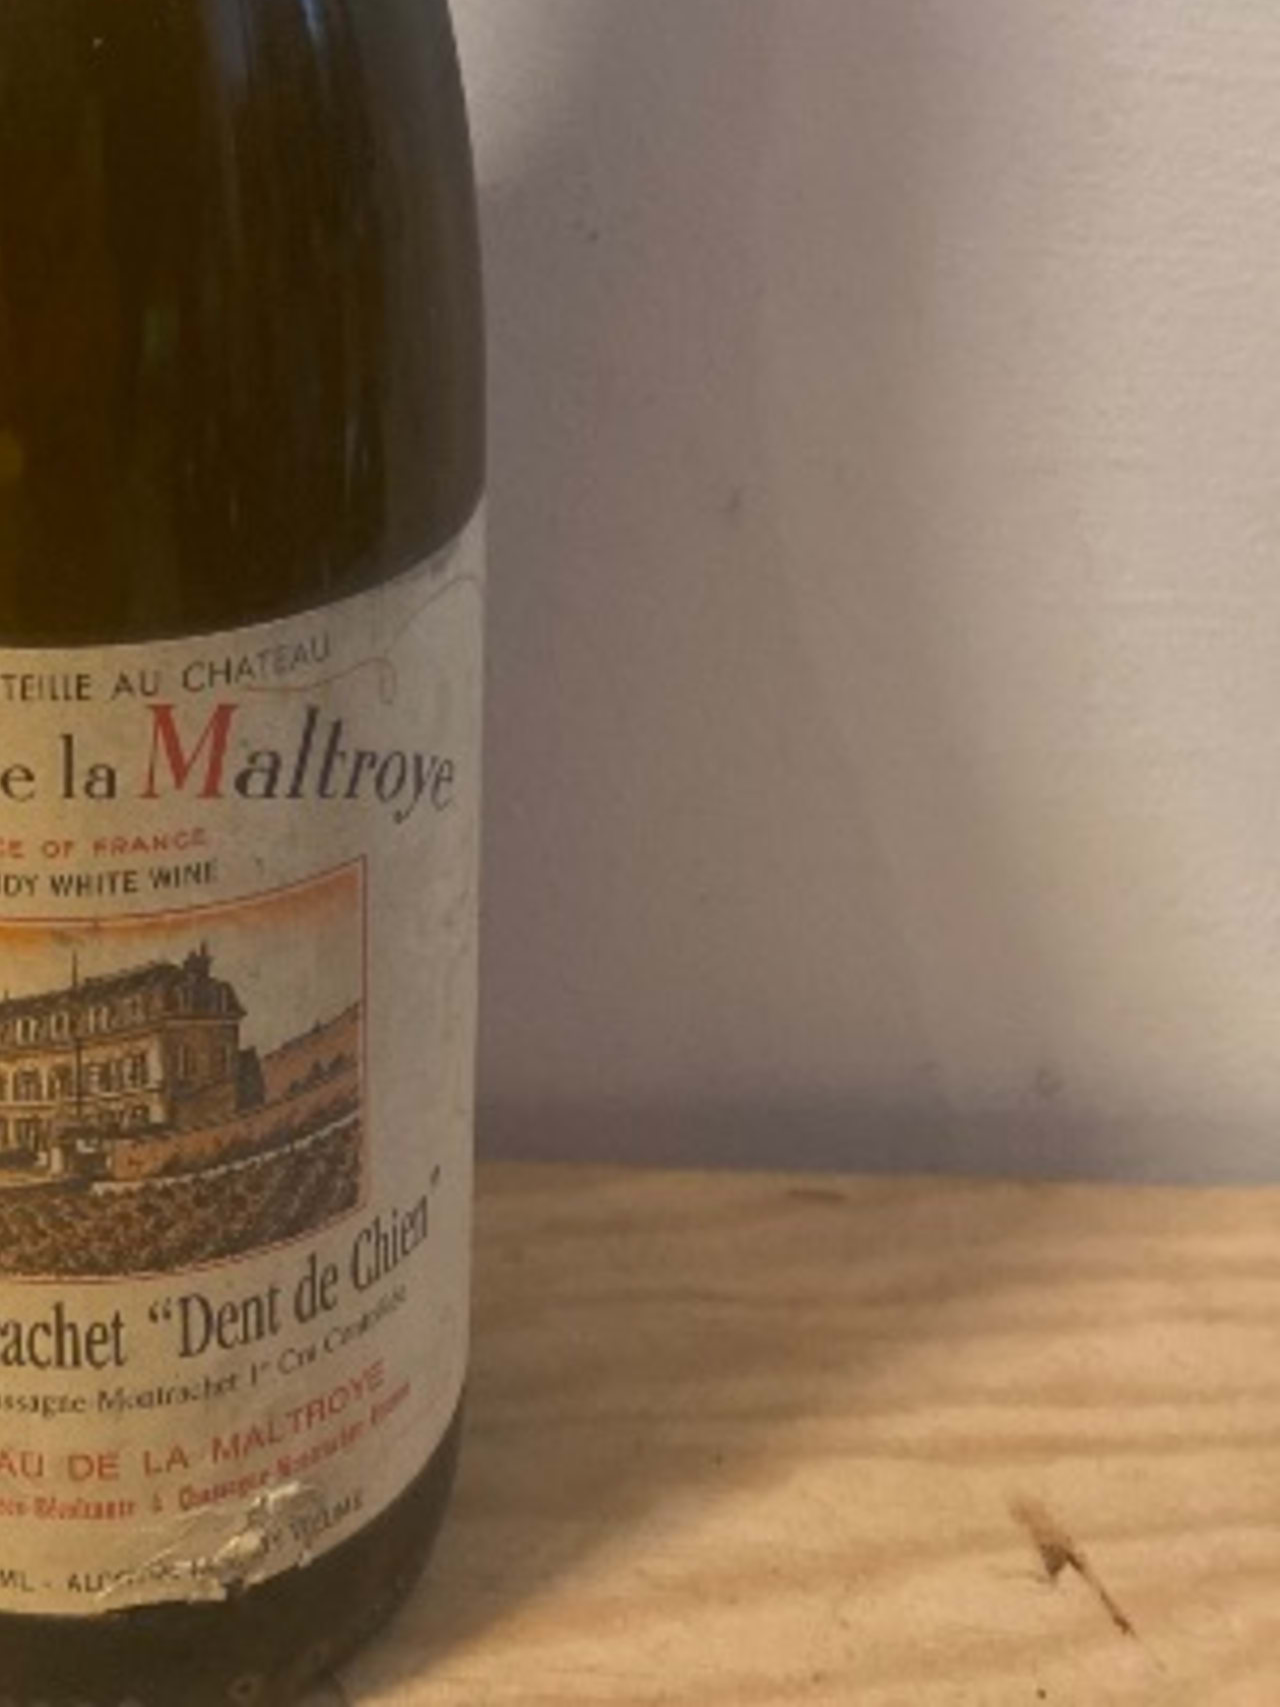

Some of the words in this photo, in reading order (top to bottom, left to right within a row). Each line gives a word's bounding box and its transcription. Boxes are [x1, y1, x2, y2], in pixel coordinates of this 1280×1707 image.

[110, 671, 161, 698] AU
[181, 633, 332, 693] CHATEAU
[58, 732, 119, 800] la
[138, 702, 456, 825] Maltroye
[40, 840, 74, 860] OF
[91, 826, 207, 859] FRANCE
[49, 869, 139, 897] WHITE
[148, 858, 219, 891] WINE
[293, 1253, 339, 1325] de
[67, 1453, 120, 1483] DE
[143, 1445, 190, 1478] LA
[211, 1359, 387, 1463] MALTROYE
